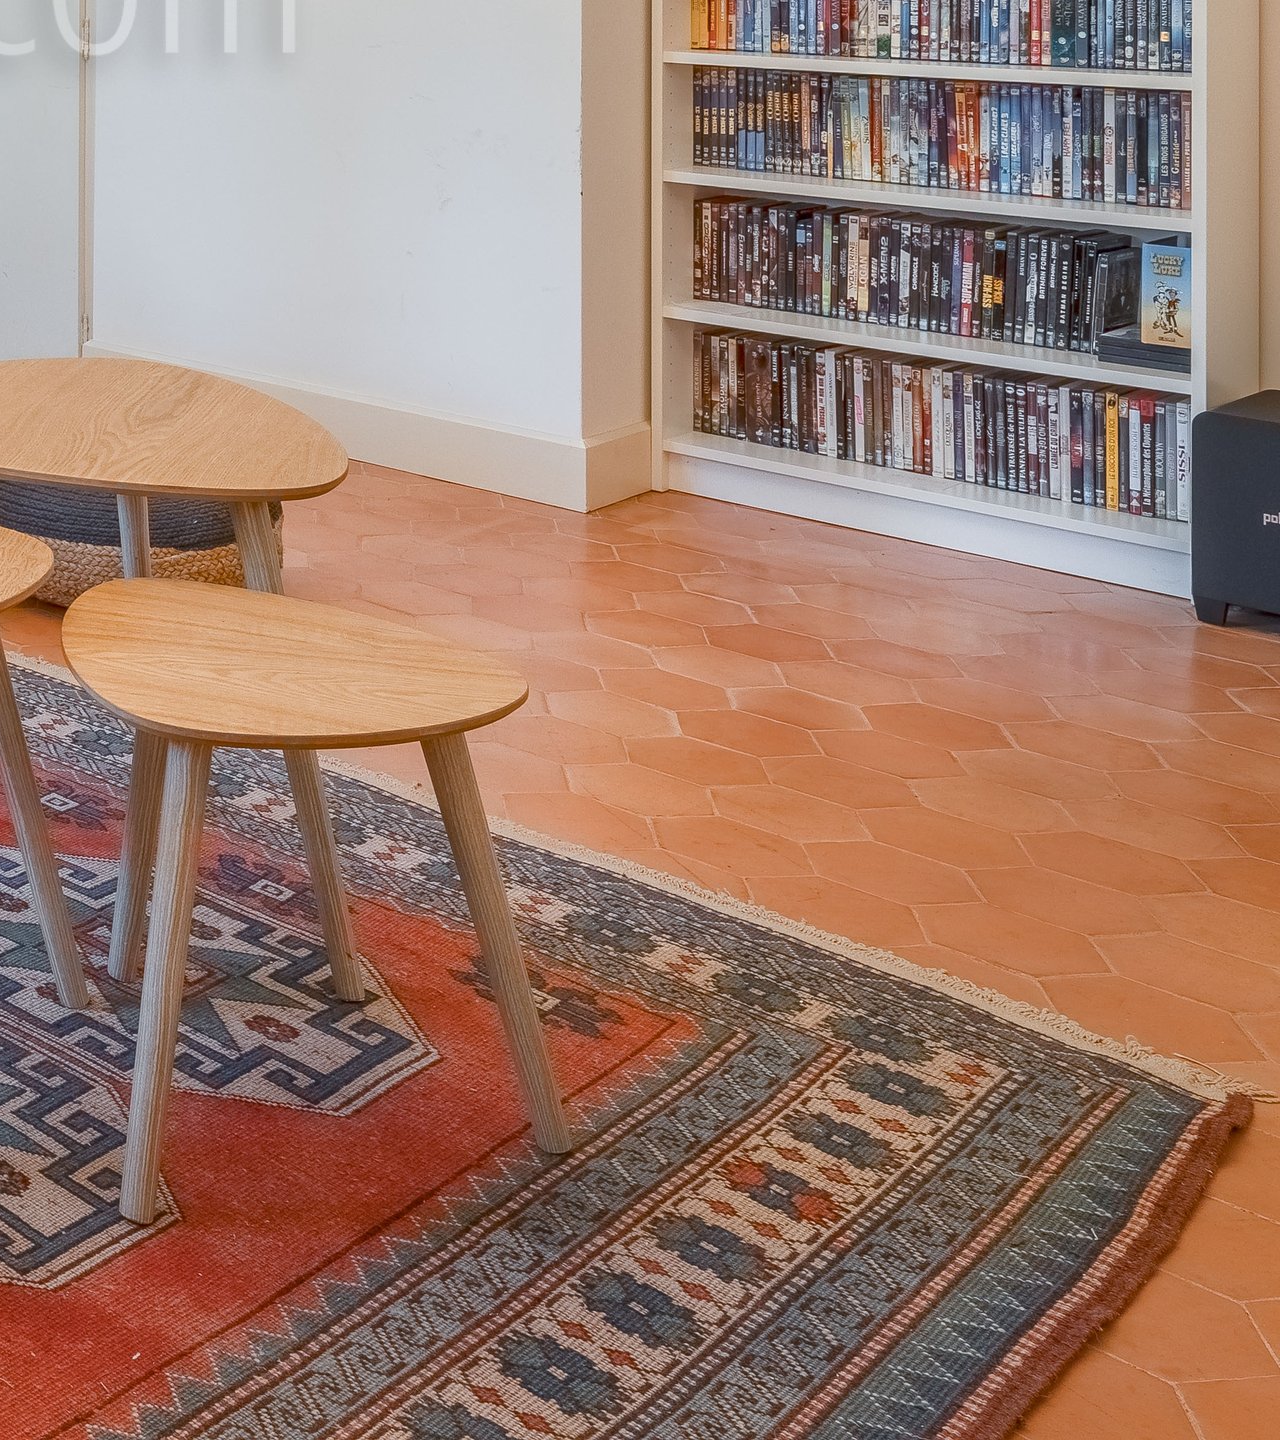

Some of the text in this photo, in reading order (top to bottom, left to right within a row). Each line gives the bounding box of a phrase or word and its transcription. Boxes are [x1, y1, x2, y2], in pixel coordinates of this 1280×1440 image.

[1171, 143, 1180, 174] Garfield
[859, 256, 867, 289] LOGAN
[870, 257, 878, 288] X-MEN
[1150, 251, 1184, 267] LUCKY
[1152, 263, 1182, 276] LUKE
[931, 262, 939, 297] HANCOCK
[962, 262, 973, 304] SUPERMAN
[982, 275, 992, 308] KICK-ASS
[1059, 260, 1068, 324] BATMAN BEGINS
[1007, 433, 1016, 468] TRAVERSÉE
[1050, 446, 1058, 470] L'ARMÉE
[1143, 458, 1152, 497] Métamorphose
